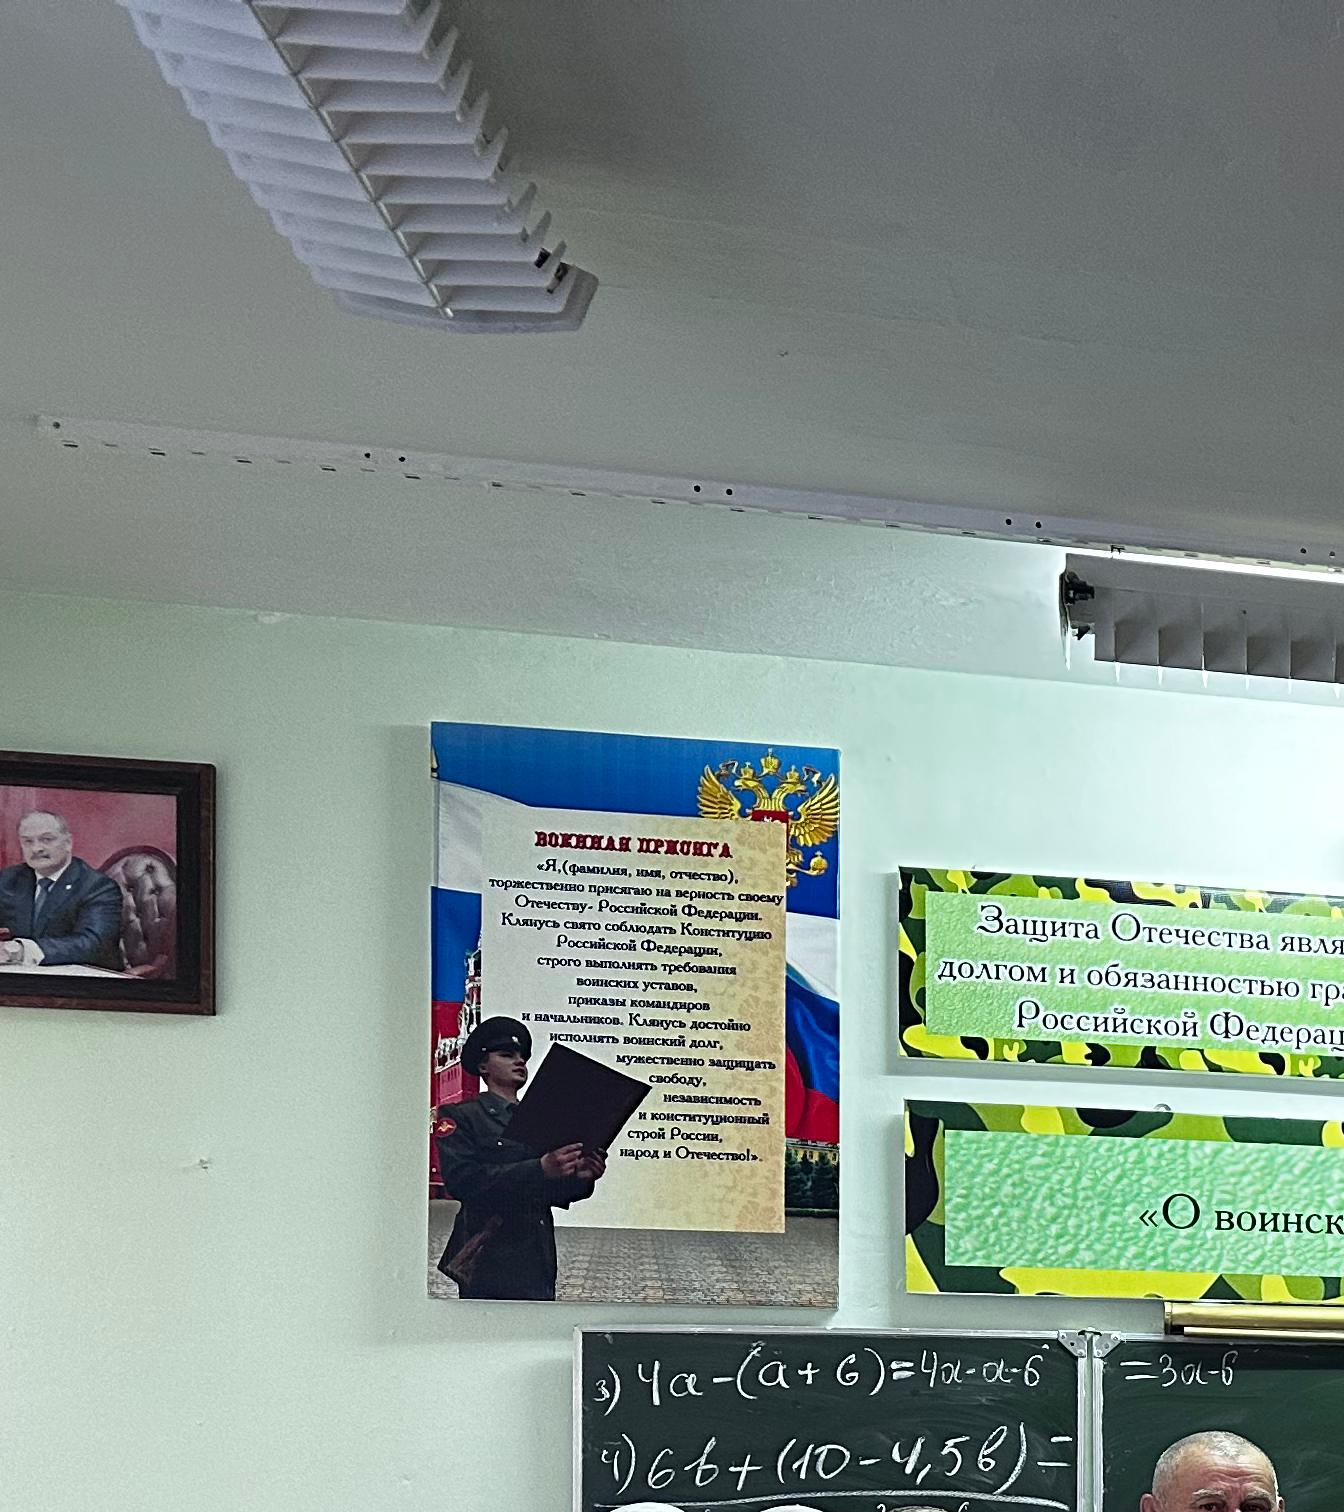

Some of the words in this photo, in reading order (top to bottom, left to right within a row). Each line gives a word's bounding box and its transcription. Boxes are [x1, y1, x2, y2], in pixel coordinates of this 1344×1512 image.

[636, 869, 666, 880] имя,
[670, 869, 738, 885] отчество),
[489, 879, 585, 892] торжественно
[588, 881, 652, 896] присягаю
[656, 889, 672, 897] на
[675, 890, 735, 901] верность
[738, 893, 784, 907] своему
[515, 894, 593, 913] Отечеству-
[598, 899, 678, 916] Российской
[681, 902, 762, 922] Федерации.
[501, 912, 560, 930] Клянусь
[564, 921, 601, 930] свято
[605, 921, 677, 935] соблюдать
[680, 922, 772, 942] Конституцию
[977, 905, 1100, 942] Защита
[1112, 913, 1270, 950] Отечества
[556, 934, 637, 951] Российской
[641, 939, 722, 957] Федерации,
[537, 957, 581, 968] строго
[585, 960, 658, 971] выполнять
[661, 962, 737, 975] требования
[576, 978, 639, 989] воинских
[642, 981, 697, 993] уставов,
[937, 958, 1047, 982] долгом
[1059, 968, 1075, 984] и
[1087, 964, 1299, 997] обязанностью
[568, 996, 626, 1008] приказы
[630, 999, 710, 1011] командиров
[522, 1013, 530, 1021] и
[534, 1014, 624, 1025] начальников.
[628, 1013, 686, 1030] Клянусь
[689, 1019, 751, 1031] достойно
[1017, 1000, 1198, 1037] Российской
[550, 1032, 619, 1044] исполнять
[623, 1034, 686, 1047] воинский
[690, 1039, 723, 1050] долг,
[616, 1055, 705, 1067] мужественно
[708, 1057, 776, 1071] защищать
[649, 1074, 706, 1087] свободу,
[663, 1094, 762, 1106] независимость
[638, 1112, 647, 1120] и
[650, 1113, 770, 1125] конституционный
[627, 1127, 665, 1142] строй
[670, 1127, 723, 1143] России,
[620, 1149, 660, 1160] народ
[663, 1150, 671, 1158] и
[1139, 1193, 1200, 1229] «О
